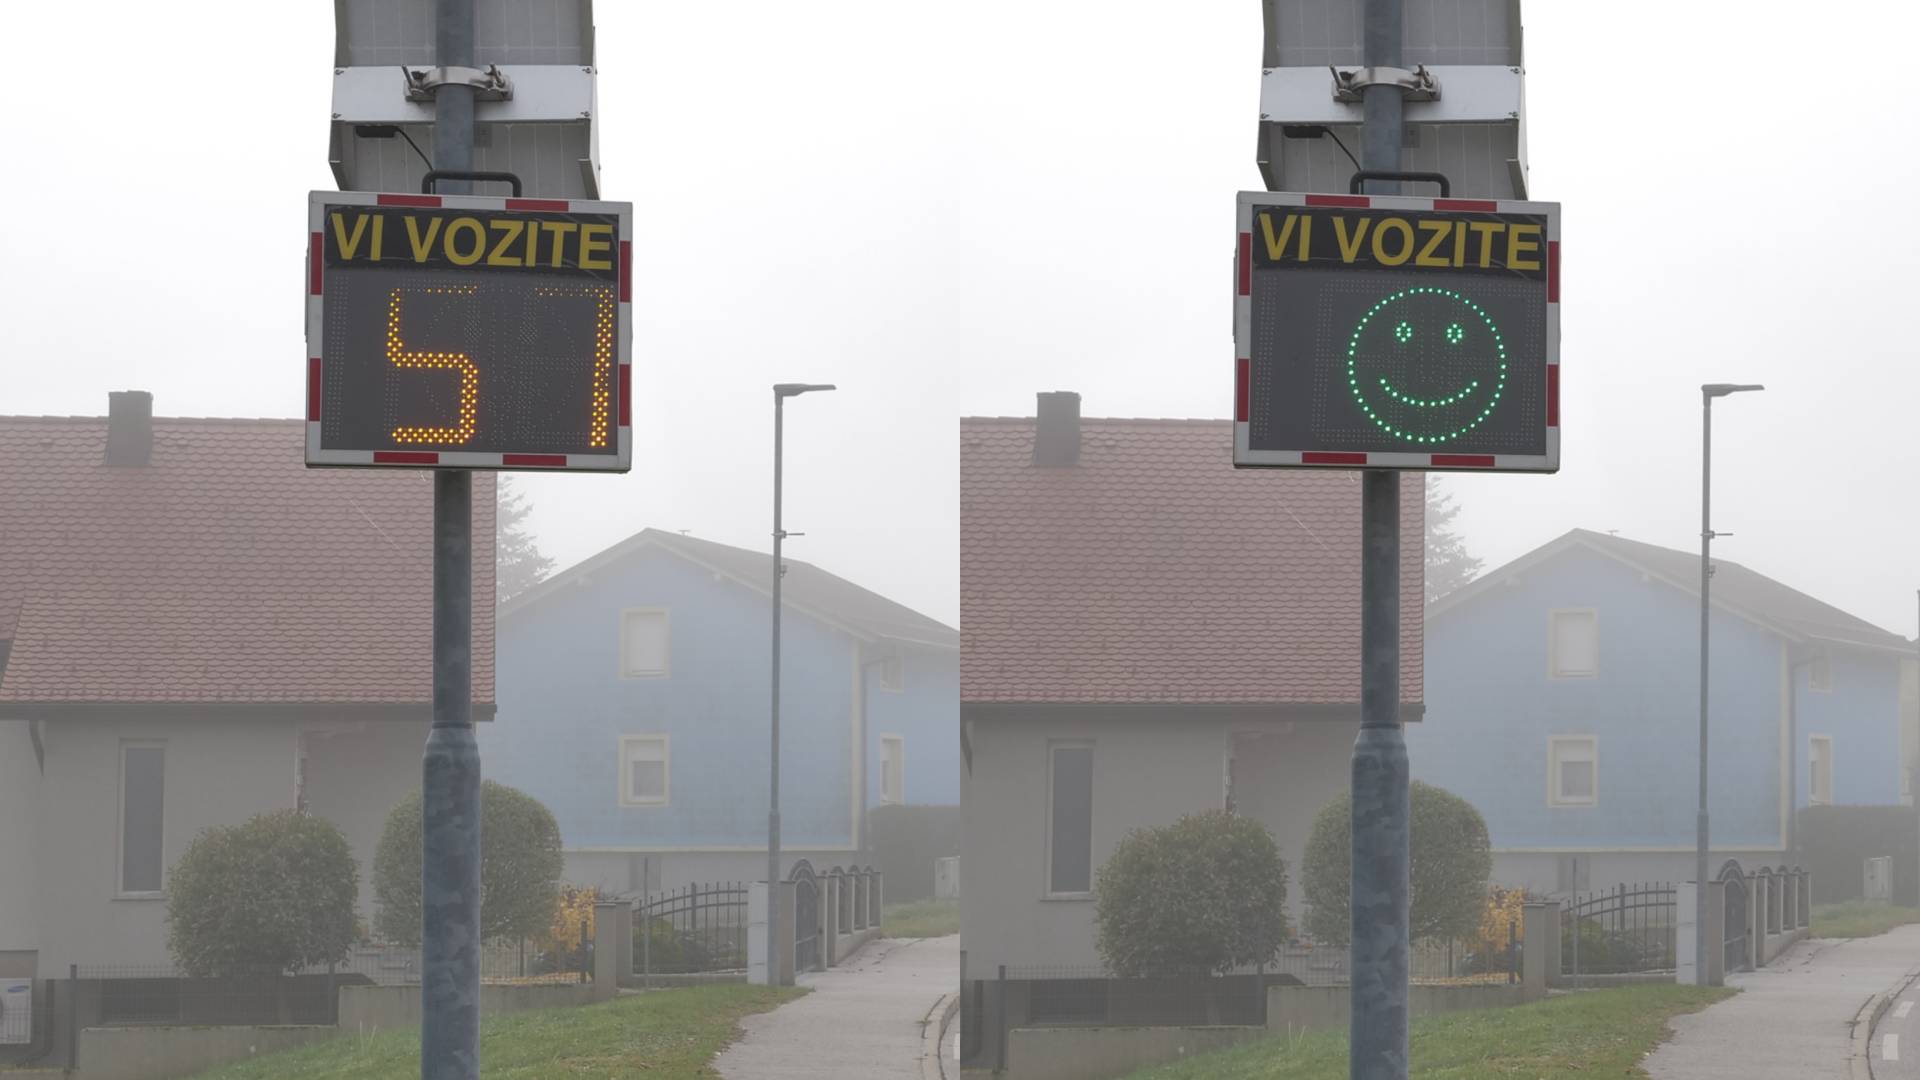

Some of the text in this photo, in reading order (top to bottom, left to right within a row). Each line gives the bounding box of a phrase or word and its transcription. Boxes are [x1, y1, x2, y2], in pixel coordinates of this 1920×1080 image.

[331, 213, 613, 270] VI VOZITE
[1259, 213, 1541, 270] VI VOZITE
